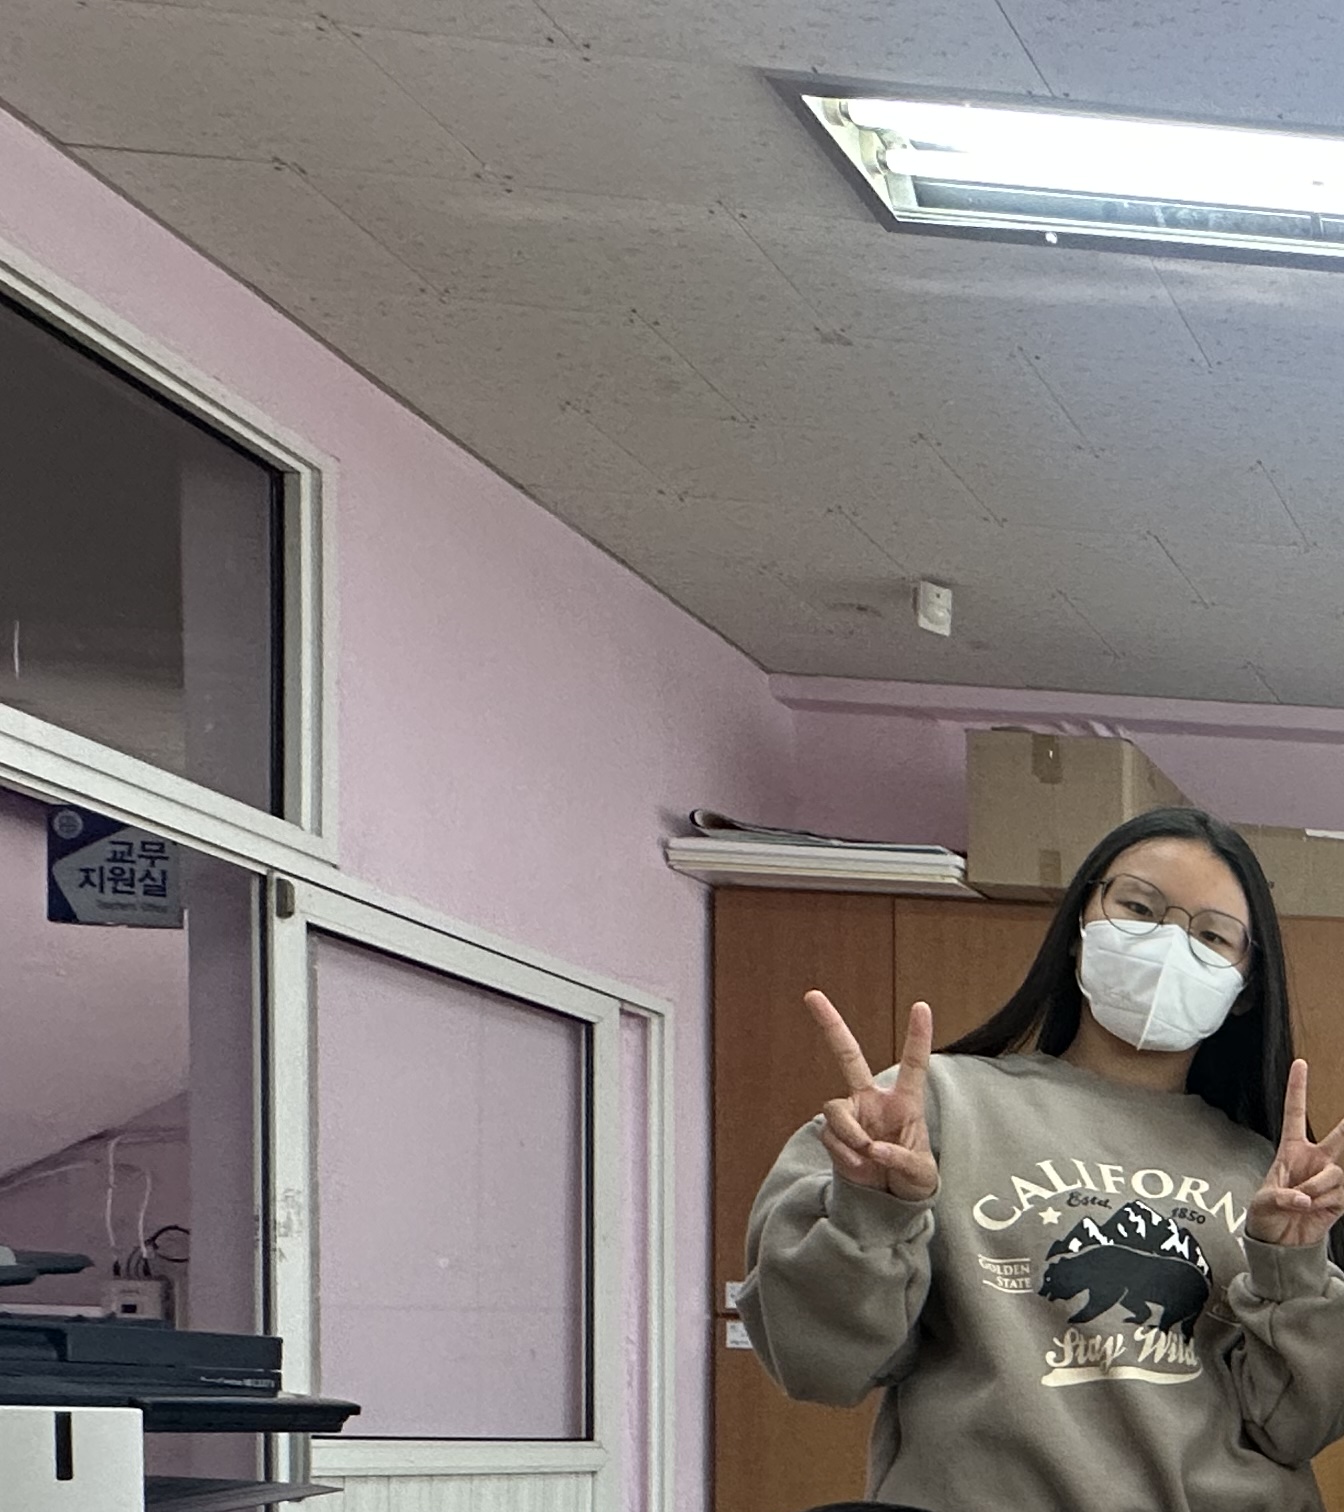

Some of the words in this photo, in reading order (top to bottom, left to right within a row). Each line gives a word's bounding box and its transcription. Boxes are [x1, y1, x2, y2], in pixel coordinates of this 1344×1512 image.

[105, 839, 169, 868] 교무
[78, 865, 168, 898] 지원실
[973, 1158, 1248, 1256] CALIFORN
[1171, 1206, 1207, 1225] 1850
[979, 1258, 1031, 1275] GOLDEN
[996, 1275, 1033, 1289] STATE
[1045, 1327, 1126, 1374] Stay
[1133, 1325, 1198, 1366] Wild
